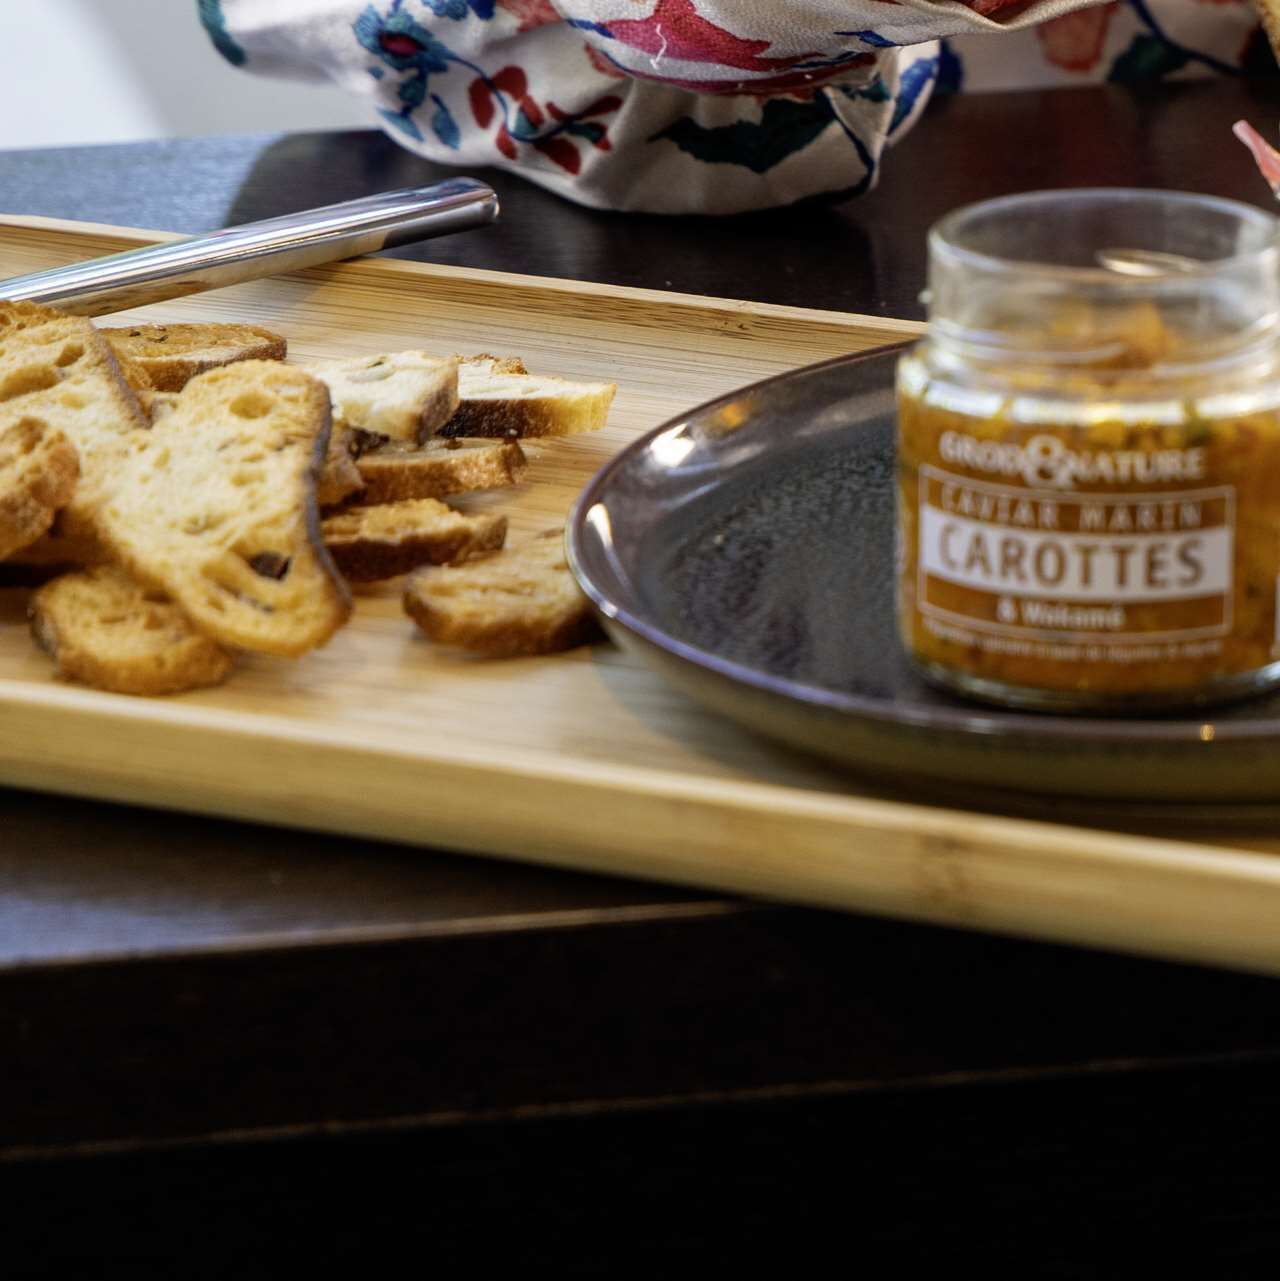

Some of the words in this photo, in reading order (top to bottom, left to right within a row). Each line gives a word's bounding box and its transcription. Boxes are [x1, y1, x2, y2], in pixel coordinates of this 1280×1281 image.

[940, 482, 1059, 528] CAVIAR
[1079, 499, 1202, 532] MARIN
[938, 522, 1206, 591] CAROTTES
